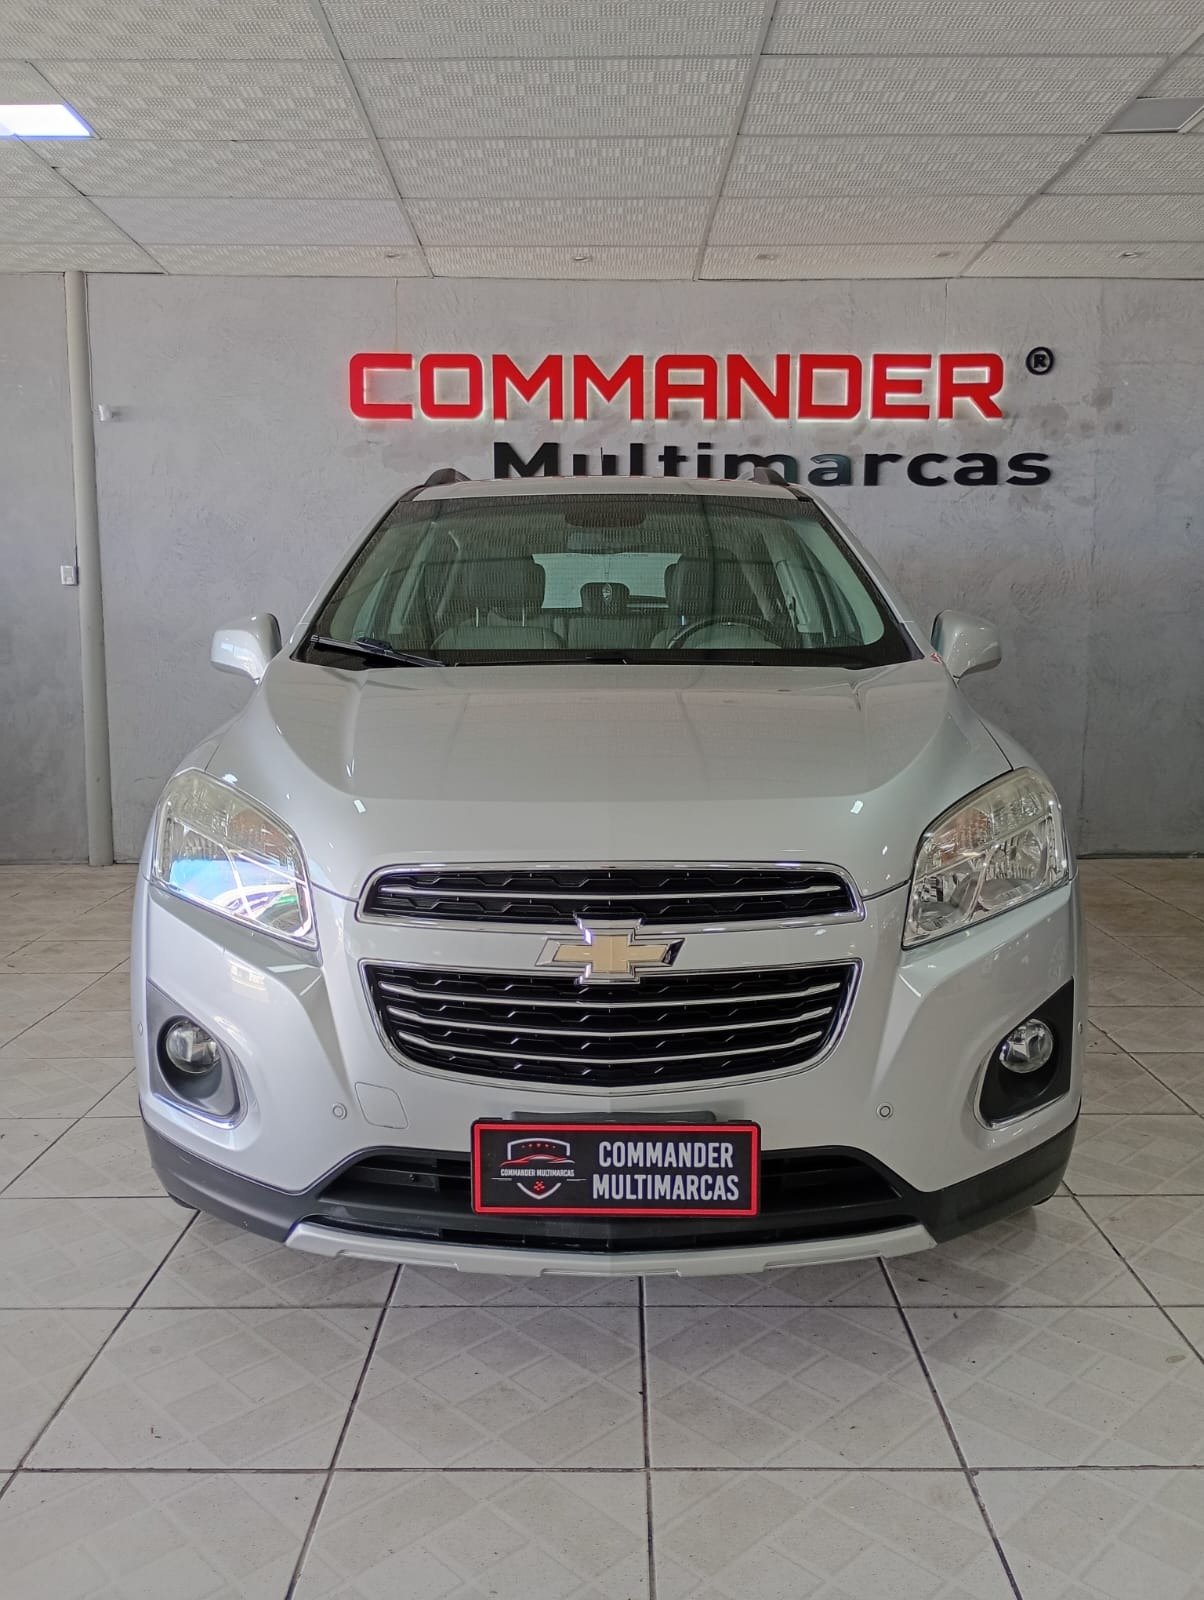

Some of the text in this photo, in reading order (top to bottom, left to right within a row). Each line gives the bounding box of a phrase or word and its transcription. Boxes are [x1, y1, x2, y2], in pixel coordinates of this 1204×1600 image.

[349, 353, 1004, 419] COMMANDER
[598, 1140, 733, 1169] COMMANDER
[500, 1168, 575, 1177] COMMANDER MULTIMARCAS
[592, 1173, 740, 1201] MULTIMARCAS
